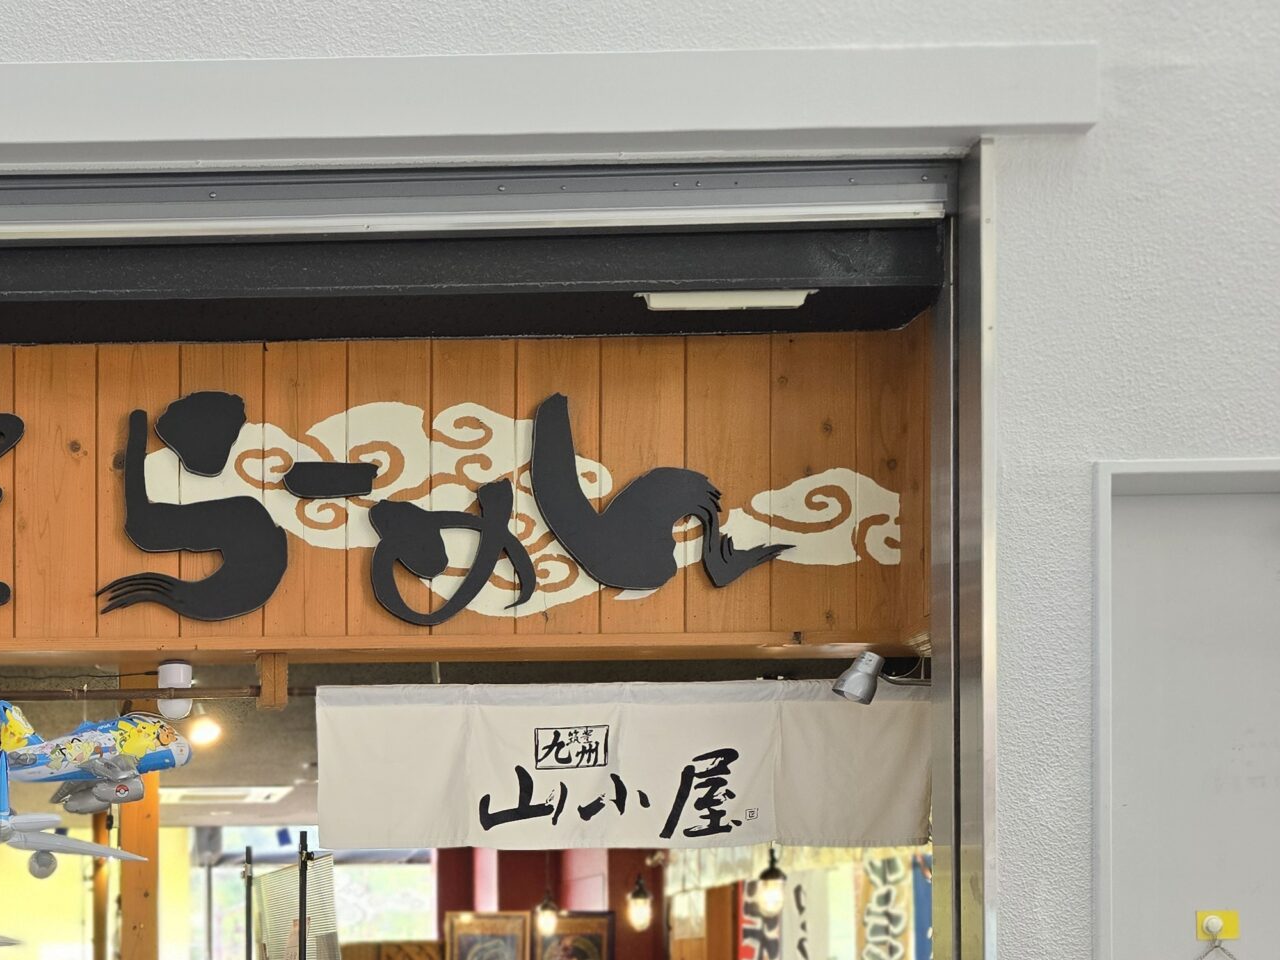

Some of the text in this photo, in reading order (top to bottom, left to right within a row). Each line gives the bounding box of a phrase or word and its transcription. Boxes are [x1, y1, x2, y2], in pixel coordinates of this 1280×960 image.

[536, 730, 600, 767] 九州
[479, 748, 742, 839] 山小屋
